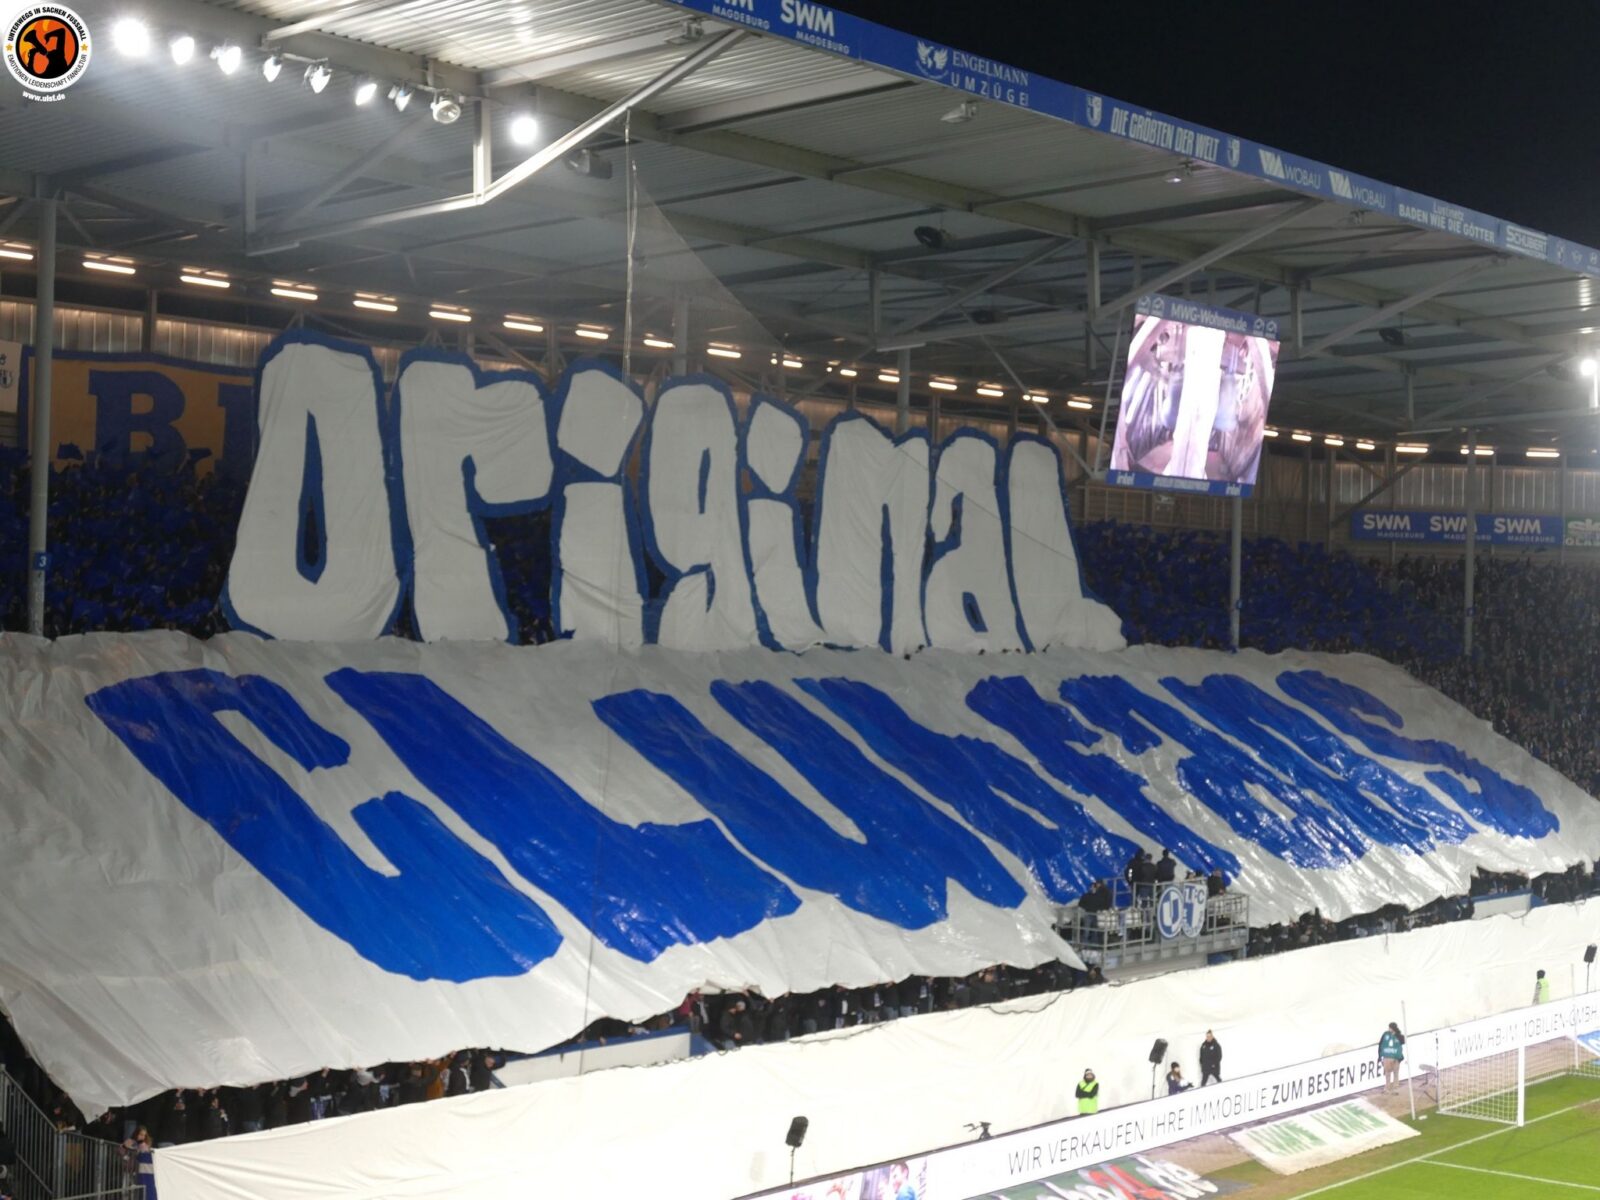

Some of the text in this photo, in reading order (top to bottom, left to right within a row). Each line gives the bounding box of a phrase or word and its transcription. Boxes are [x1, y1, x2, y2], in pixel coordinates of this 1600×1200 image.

[712, 4, 770, 30] MAGDEBURG
[780, 0, 834, 37] SWM
[795, 30, 850, 55] MAGDEBURG
[952, 50, 1029, 87] ENGELMANN
[1110, 107, 1129, 136] DIE
[1174, 126, 1195, 155] DER
[1195, 132, 1220, 162] WELT
[1284, 164, 1321, 189] WOBAU
[1352, 185, 1386, 208] WOBAU
[1398, 203, 1429, 224] BADEN
[1429, 212, 1447, 229] WIE
[1447, 217, 1462, 234] DIE
[1363, 513, 1411, 531] SWM
[1429, 515, 1478, 533] SWM
[1494, 517, 1542, 534] SWM
[39, 556, 47, 568] 3
[1008, 1146, 1042, 1176] WIR
[1048, 1121, 1145, 1165] VERKAUFEN
[1150, 1108, 1185, 1137] IHRE
[1190, 1088, 1267, 1127] IMMOBILIE
[1271, 1078, 1303, 1105] ZUM
[1308, 1065, 1355, 1097] BESTEN
